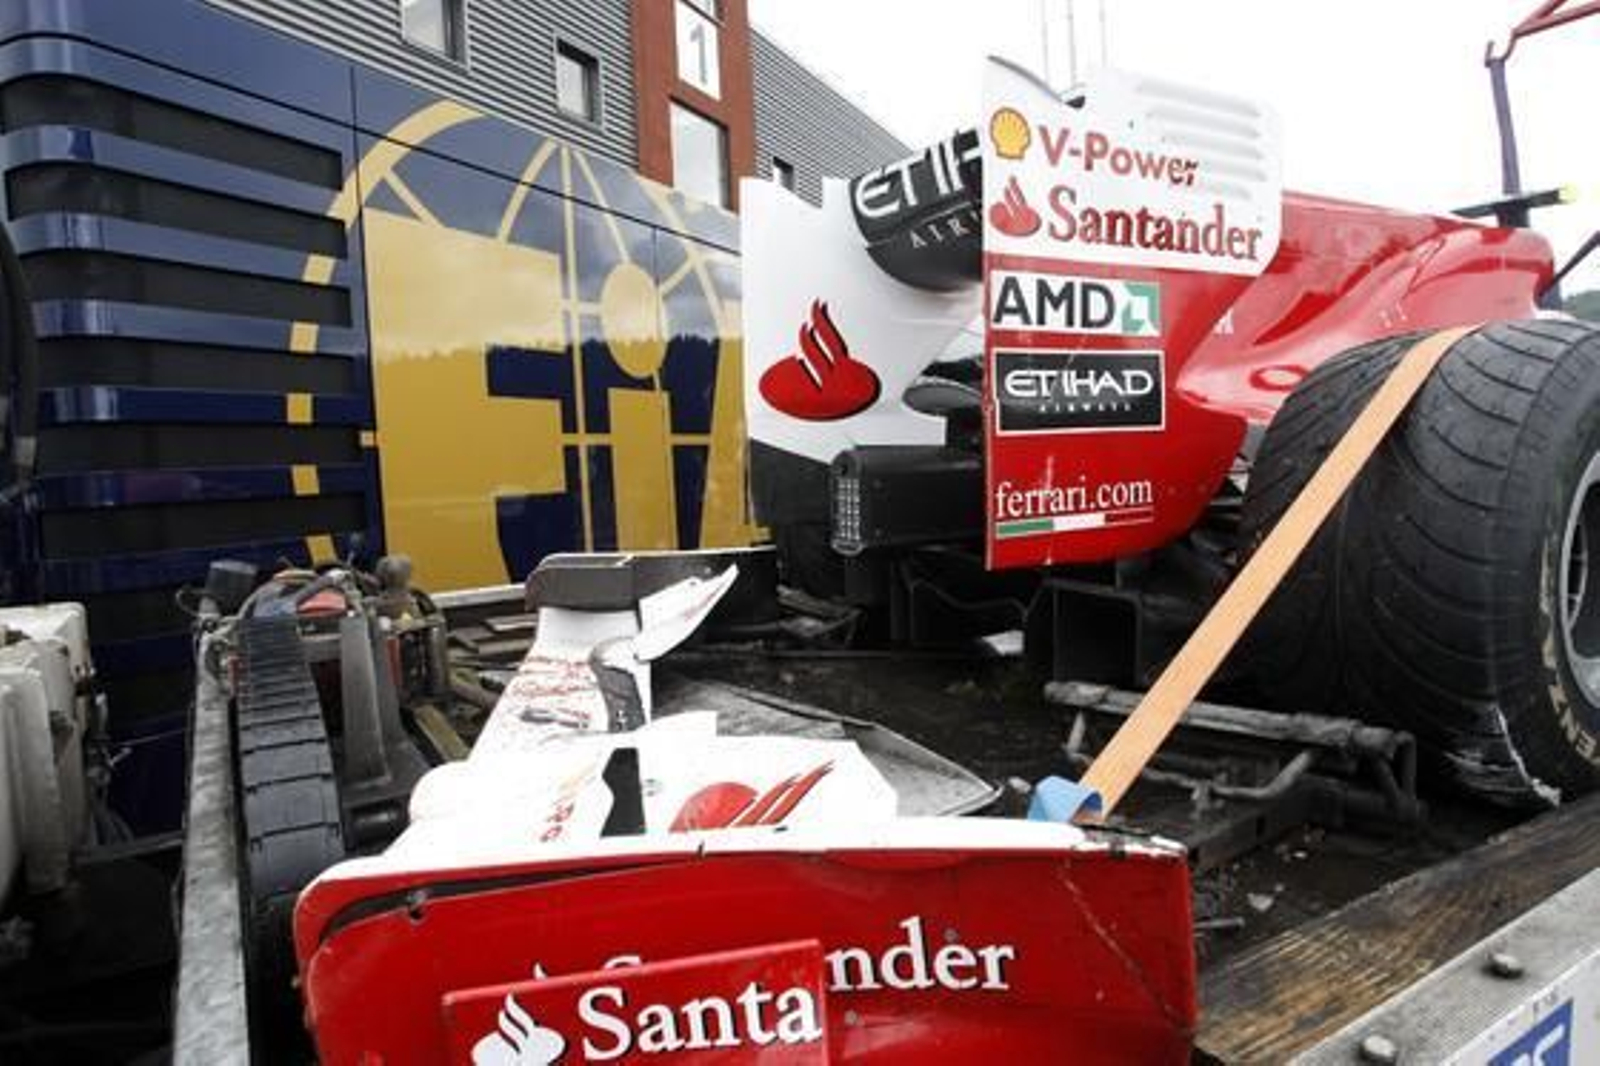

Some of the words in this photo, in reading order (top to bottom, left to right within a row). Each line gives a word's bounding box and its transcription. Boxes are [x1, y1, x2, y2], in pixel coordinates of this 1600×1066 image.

[689, 21, 708, 87] 1
[1037, 123, 1198, 186] V-Power
[1048, 183, 1263, 261] Santander
[992, 275, 1116, 329] AMD
[1003, 369, 1154, 397] ETIHAD
[995, 474, 1154, 519] ferrari.com
[577, 984, 823, 1060] Santa
